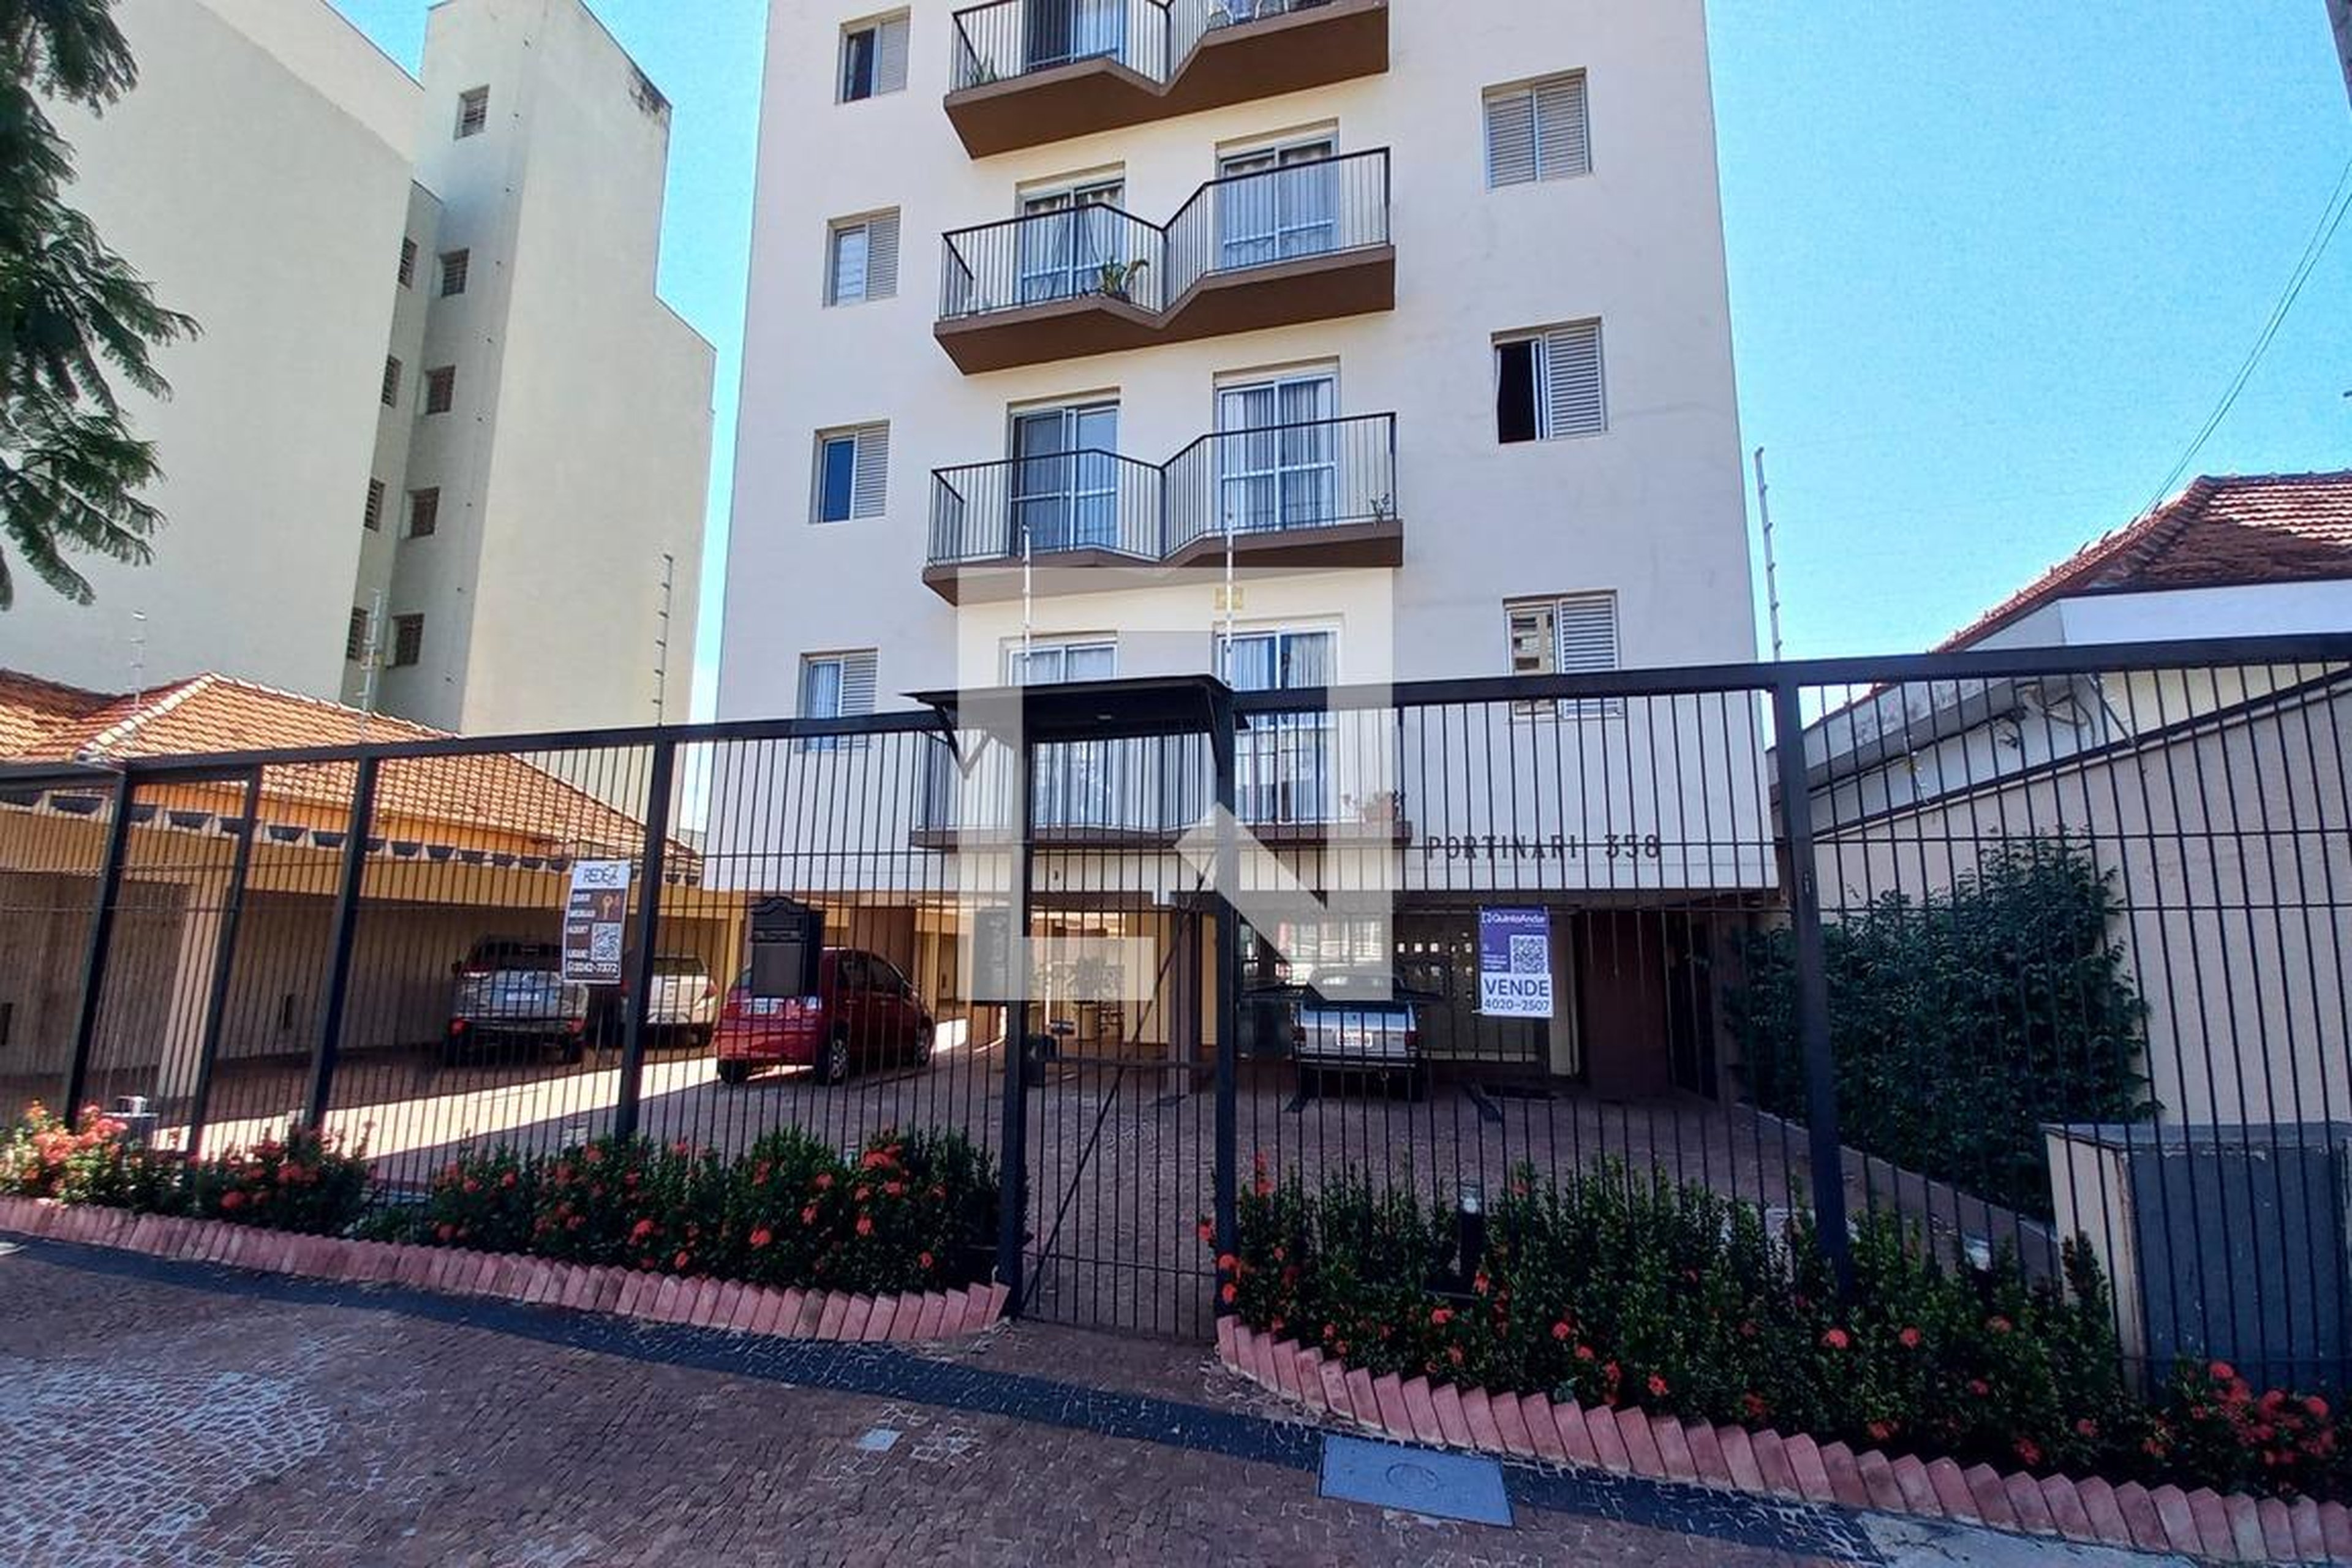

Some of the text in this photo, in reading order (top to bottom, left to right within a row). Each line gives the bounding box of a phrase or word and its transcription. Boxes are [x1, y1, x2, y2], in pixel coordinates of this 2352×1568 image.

[1428, 834, 1660, 859] PORTINARI 358
[1484, 978, 1550, 997] VENDE
